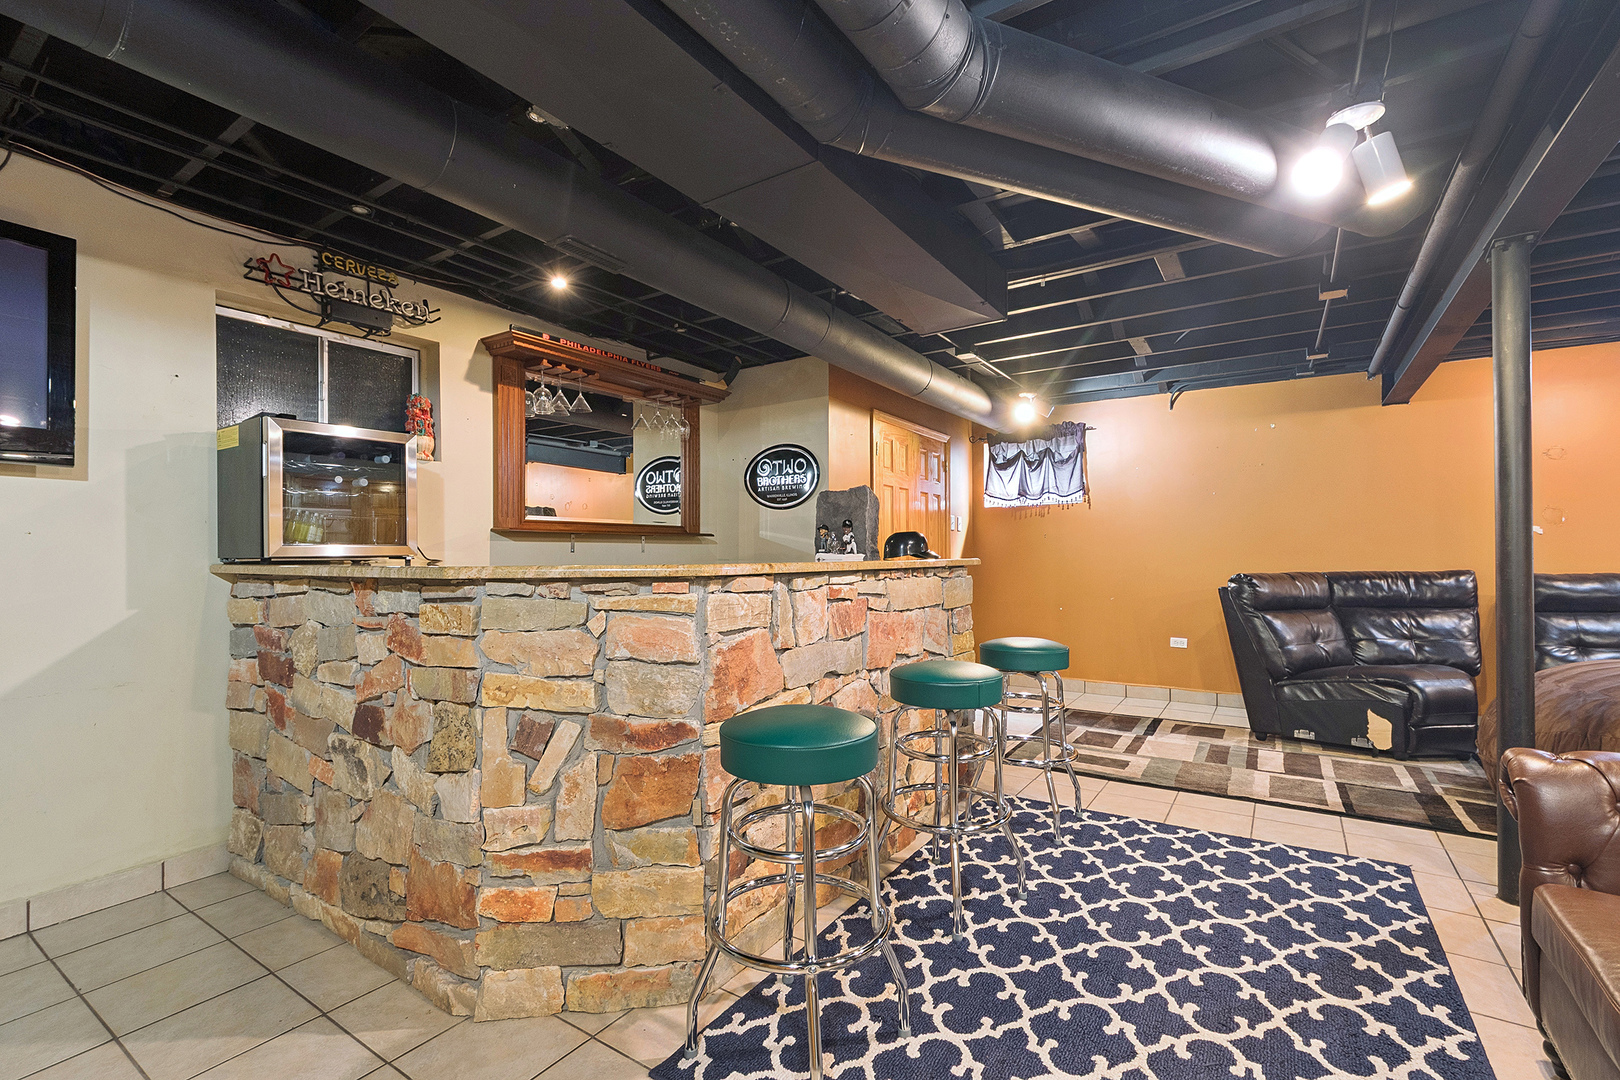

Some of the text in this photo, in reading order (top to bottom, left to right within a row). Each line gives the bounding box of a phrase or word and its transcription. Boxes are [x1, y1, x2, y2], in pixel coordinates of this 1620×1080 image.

[321, 252, 399, 284] CERVEZA
[300, 268, 432, 322] Heineken
[559, 338, 662, 373] PHILADELPHIA FLYERS
[757, 474, 807, 487] BROTHERS
[772, 458, 807, 476] TWO
